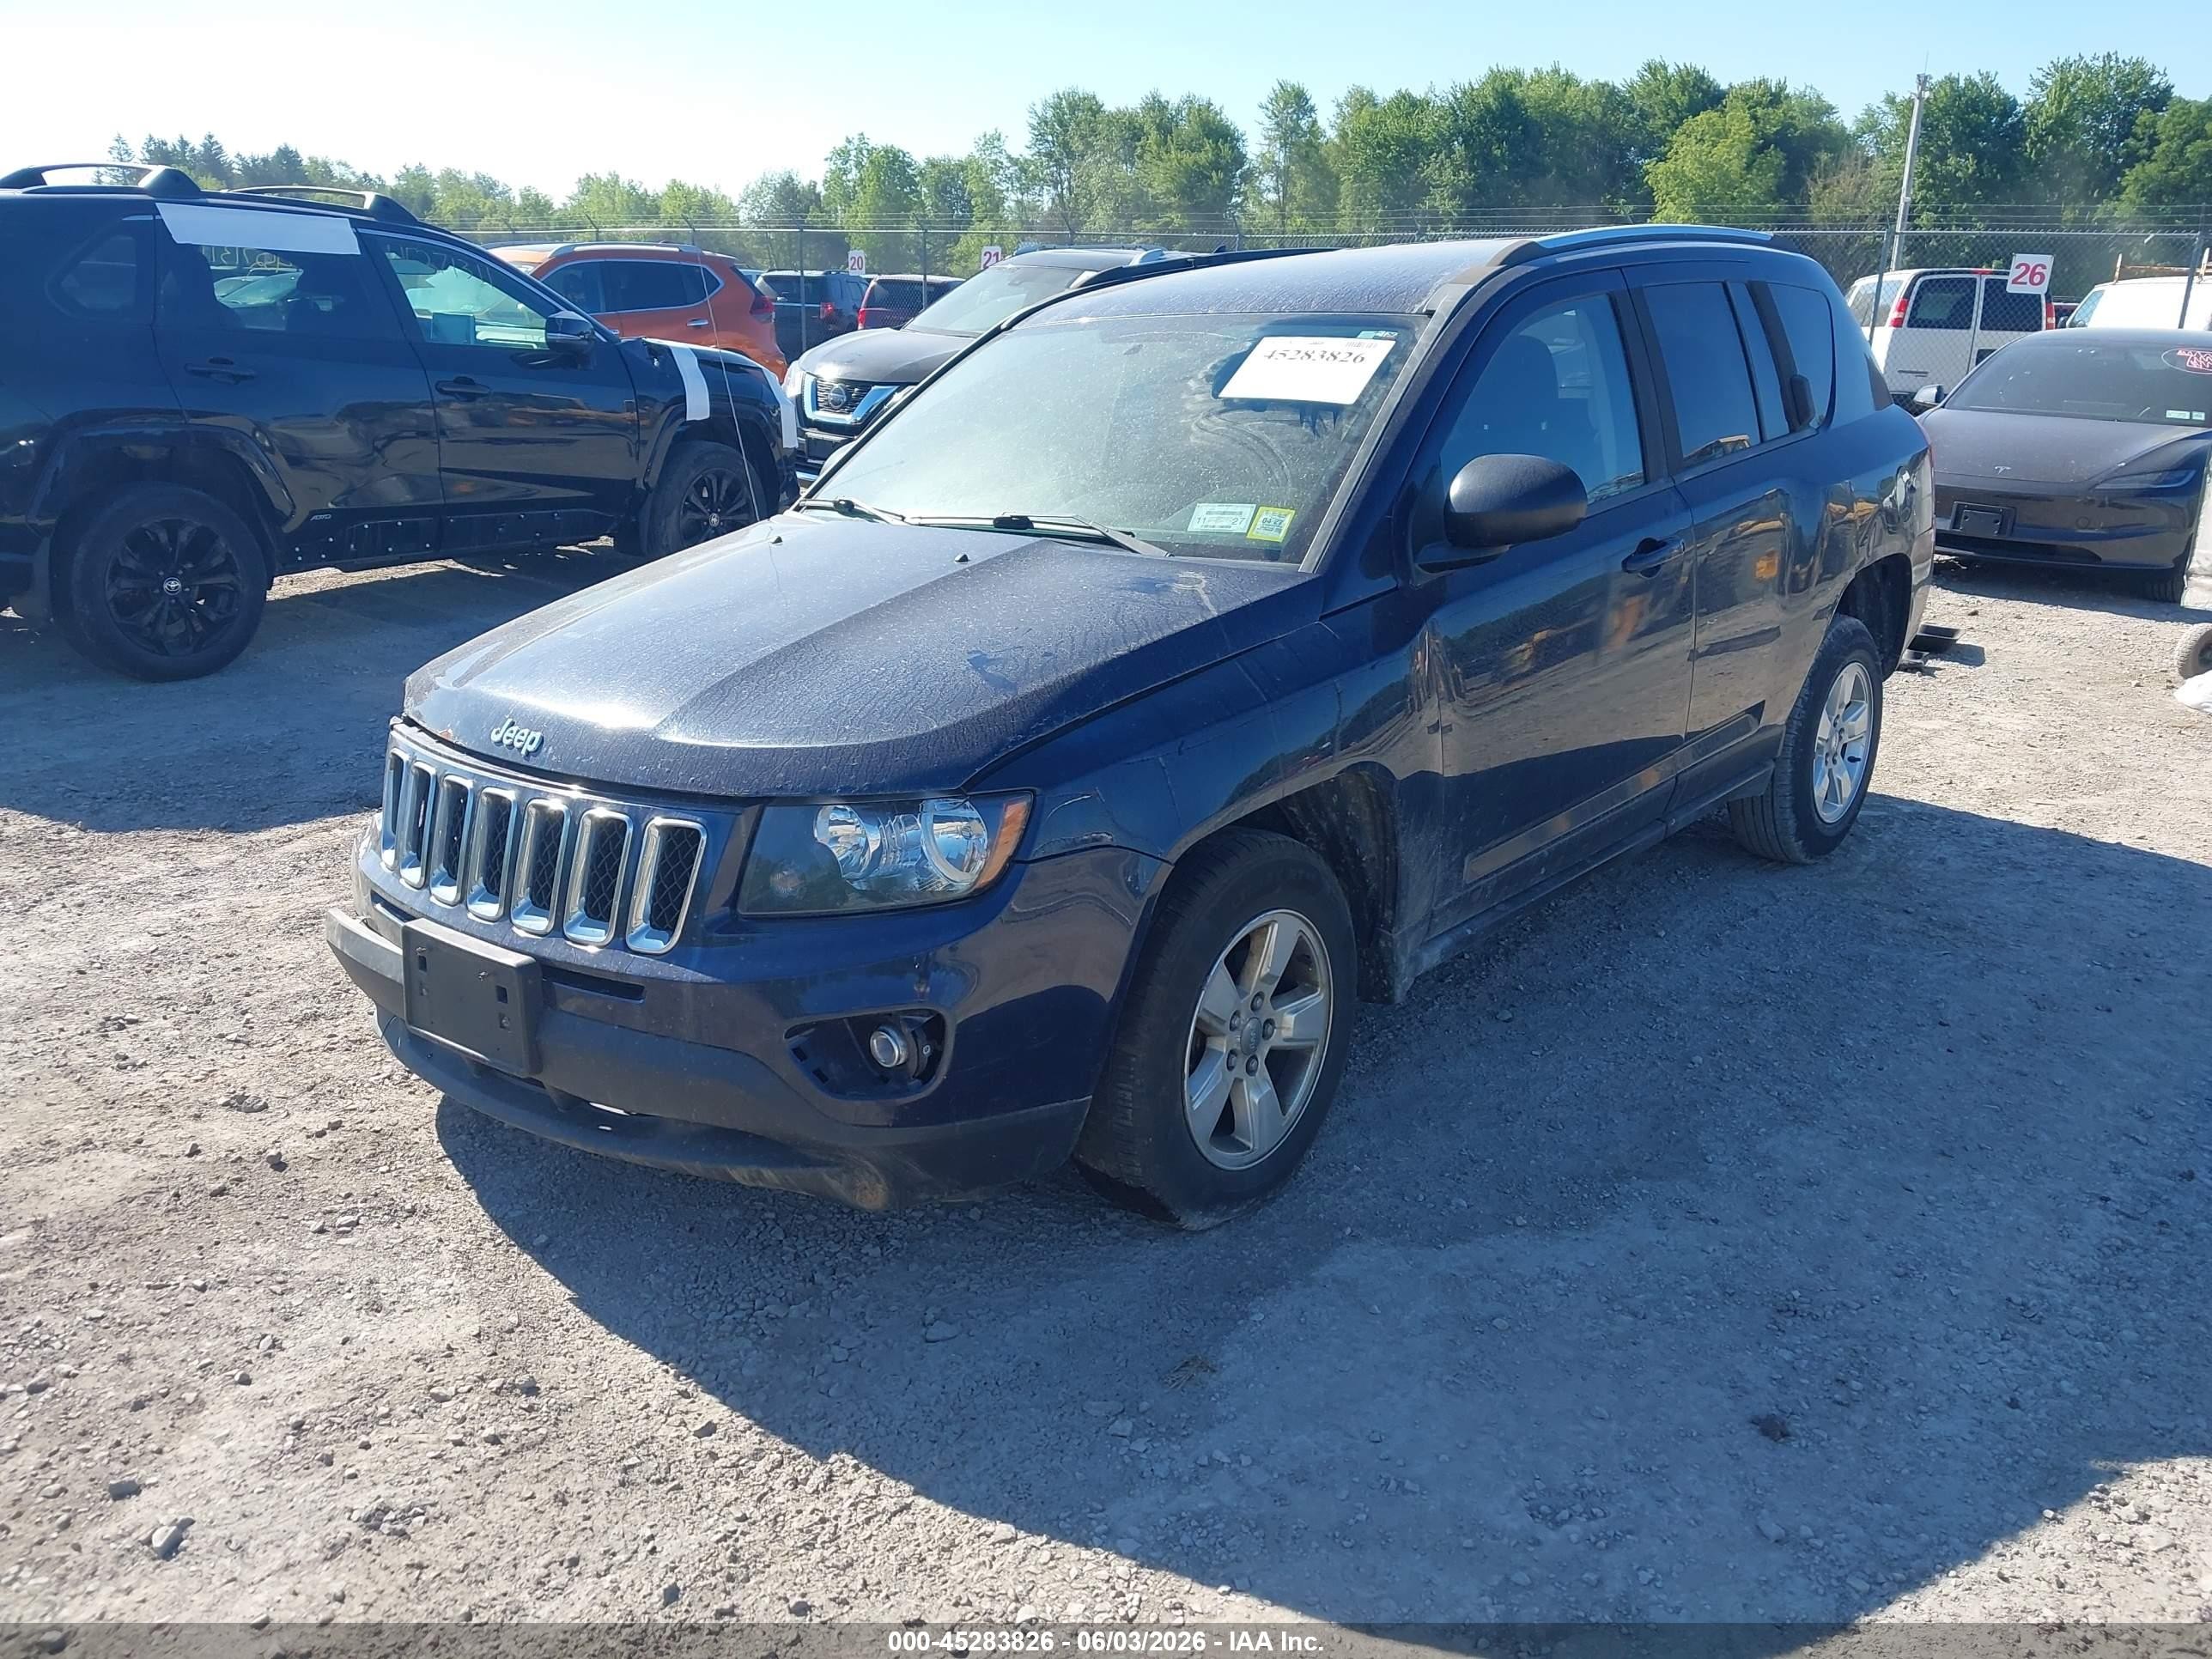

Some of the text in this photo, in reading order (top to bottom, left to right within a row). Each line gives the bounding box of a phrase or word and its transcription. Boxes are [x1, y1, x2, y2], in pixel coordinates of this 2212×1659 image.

[850, 256, 863, 270] 20
[983, 251, 1000, 269] 21
[2011, 262, 2047, 286] 26
[1264, 349, 1365, 364] 45283826
[1231, 517, 1246, 526] 27
[490, 718, 544, 757] Jeep
